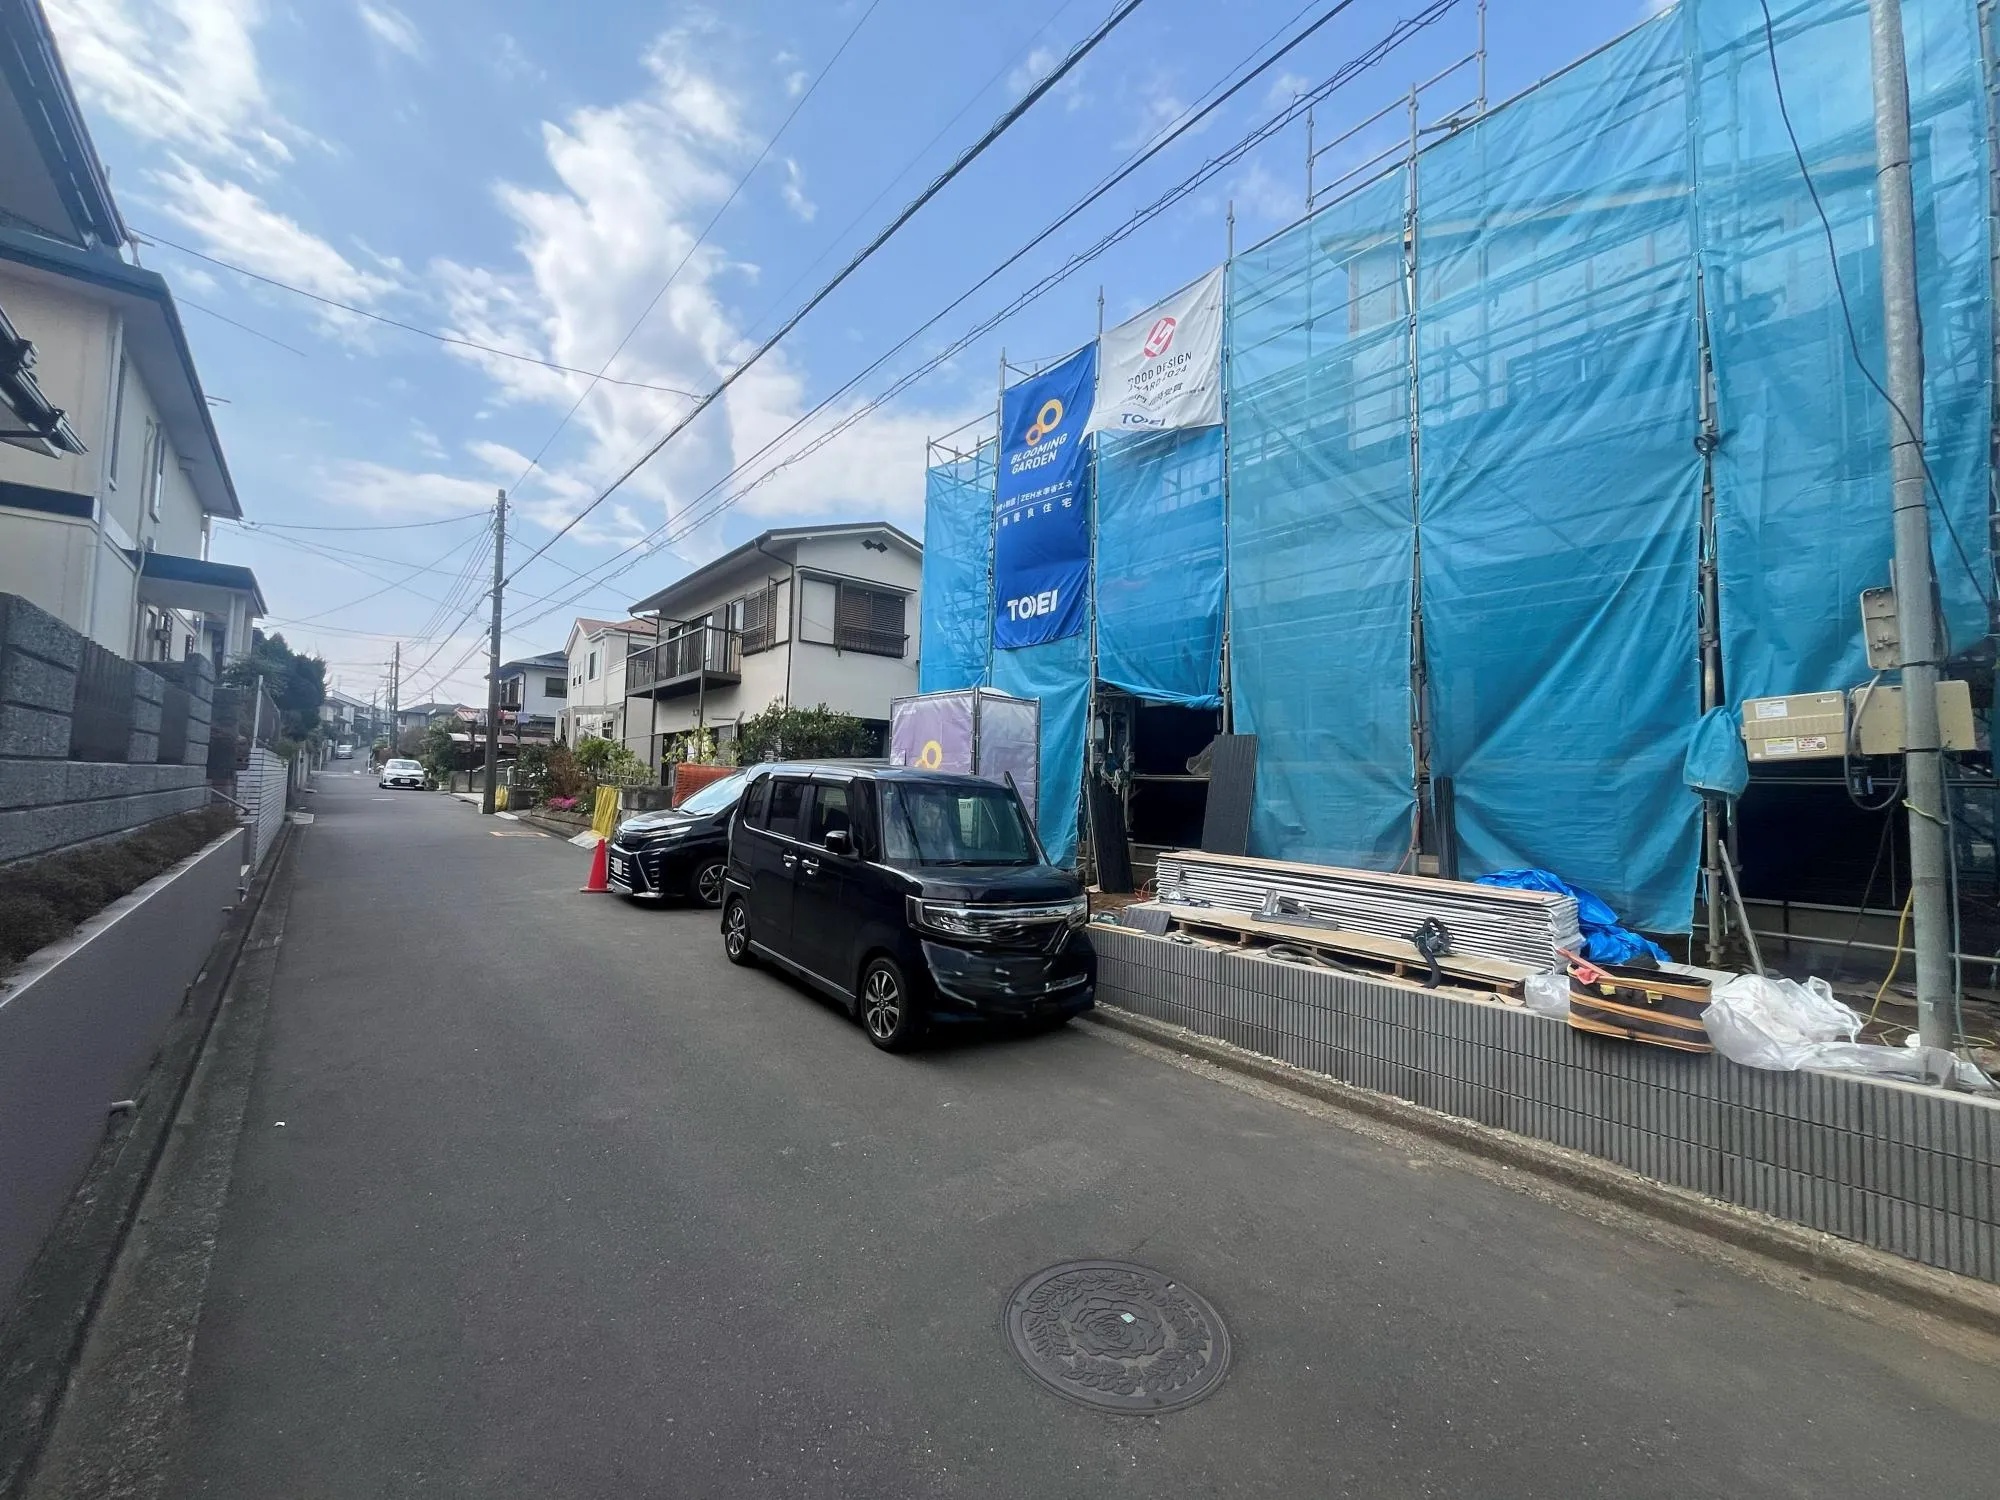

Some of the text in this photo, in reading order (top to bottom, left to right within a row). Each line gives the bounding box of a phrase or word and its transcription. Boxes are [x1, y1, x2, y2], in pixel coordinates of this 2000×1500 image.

[1156, 352, 1192, 375] DESIGN
[1010, 433, 1068, 465] BLOOMING
[1011, 449, 1058, 475] GARDEN
[1007, 588, 1058, 621] TOEI
